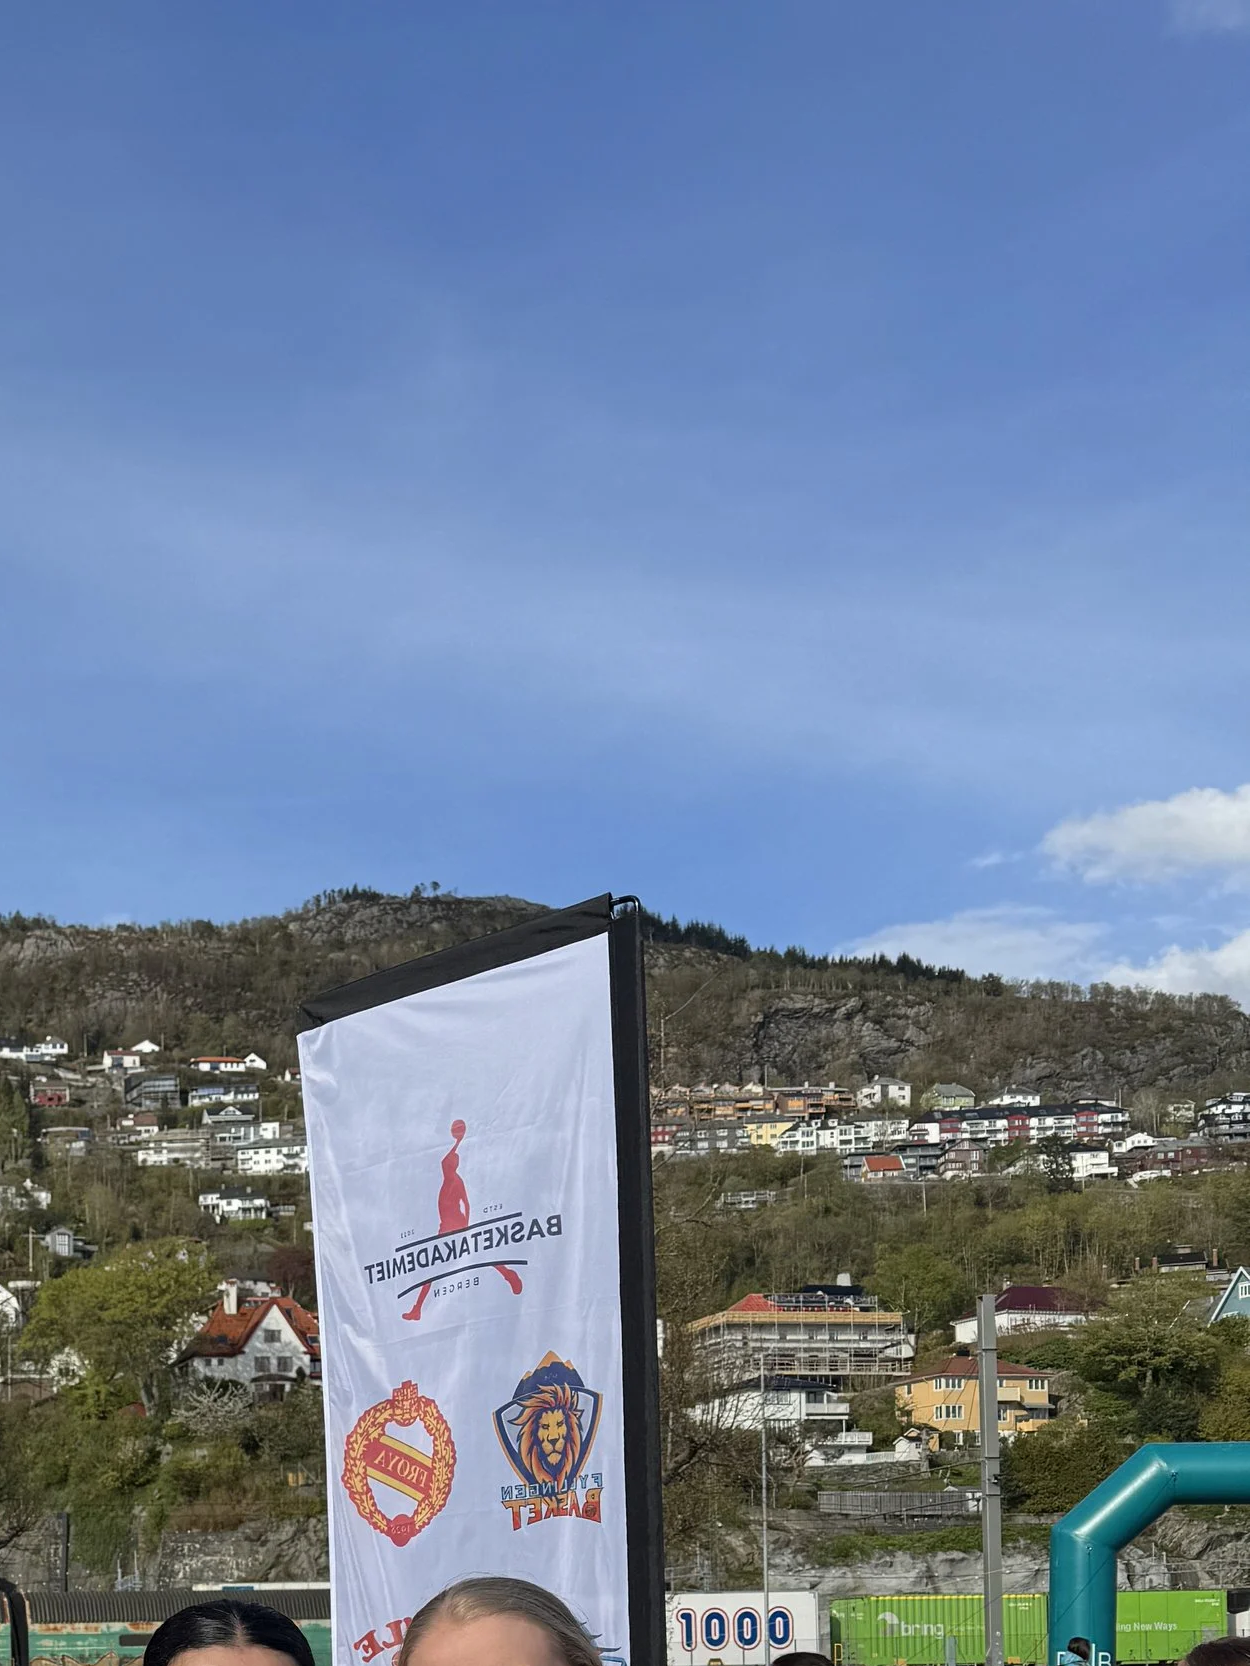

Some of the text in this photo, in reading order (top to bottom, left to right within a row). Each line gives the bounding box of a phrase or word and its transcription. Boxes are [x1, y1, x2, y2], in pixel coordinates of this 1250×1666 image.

[676, 1606, 793, 1652] 1000
[901, 1620, 944, 1640] bring
[1133, 1622, 1152, 1631] New
[1154, 1622, 1178, 1632] Ways
